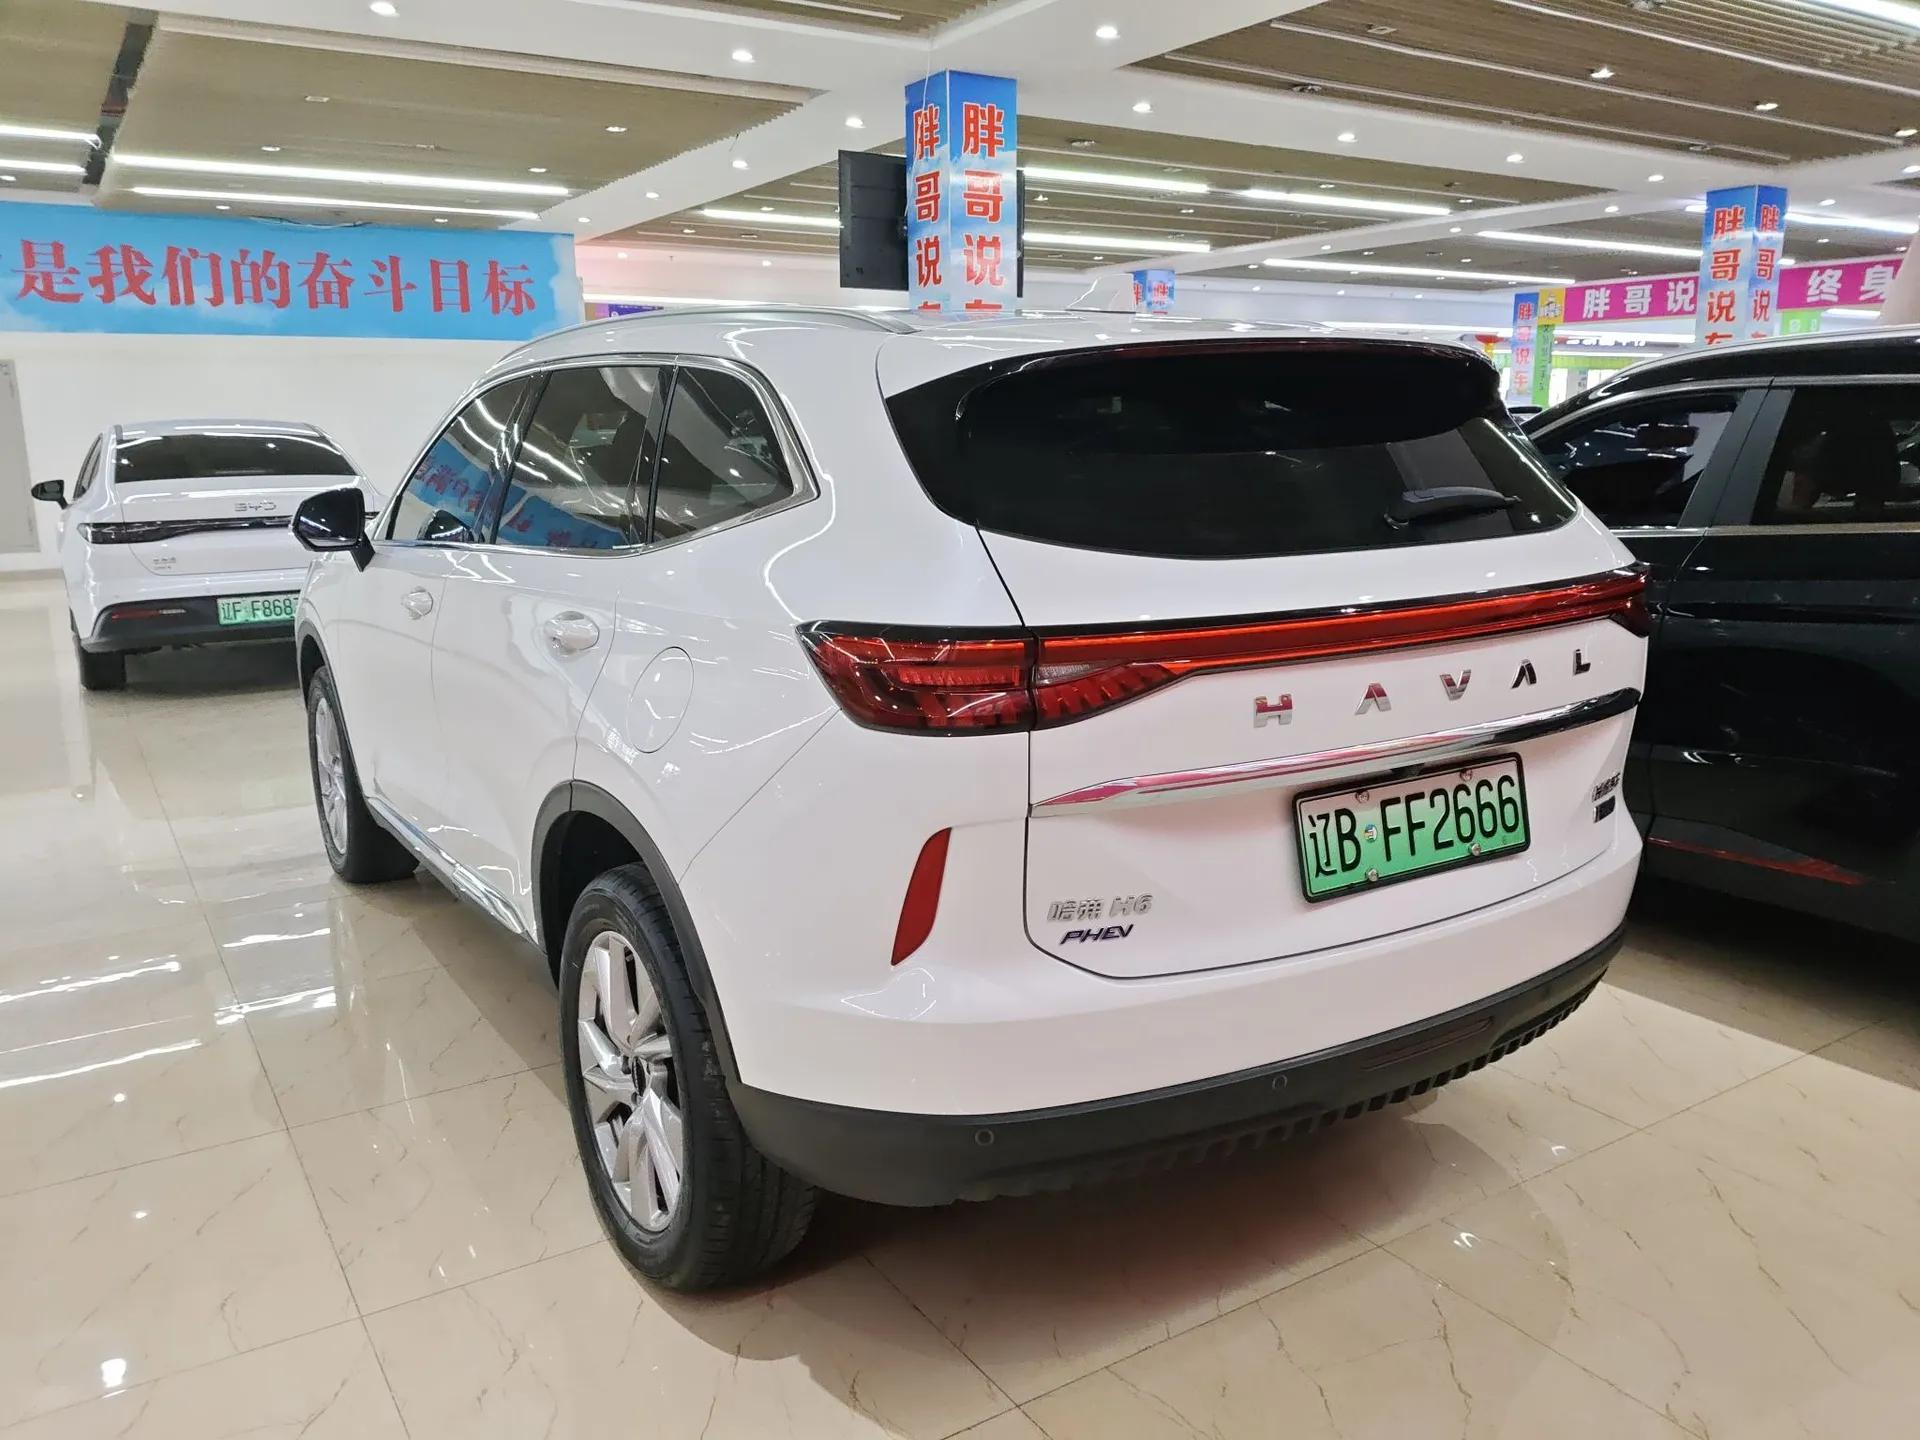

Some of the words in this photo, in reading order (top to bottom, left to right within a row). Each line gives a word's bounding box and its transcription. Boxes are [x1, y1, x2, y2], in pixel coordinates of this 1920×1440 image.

[914, 103, 943, 312] 胖哥说
[962, 102, 1005, 312] 胖哥说
[10, 239, 536, 316] 是我们的奋斗目标
[1582, 281, 1697, 319] 胖哥说
[1751, 205, 1780, 338] 胖哥说
[1806, 265, 1894, 303] 终身
[251, 597, 299, 619] F868
[1253, 649, 1592, 728] HAVAL
[1380, 774, 1519, 862] FF2666
[1060, 924, 1134, 945] PHEV
[1109, 894, 1153, 918] H6
